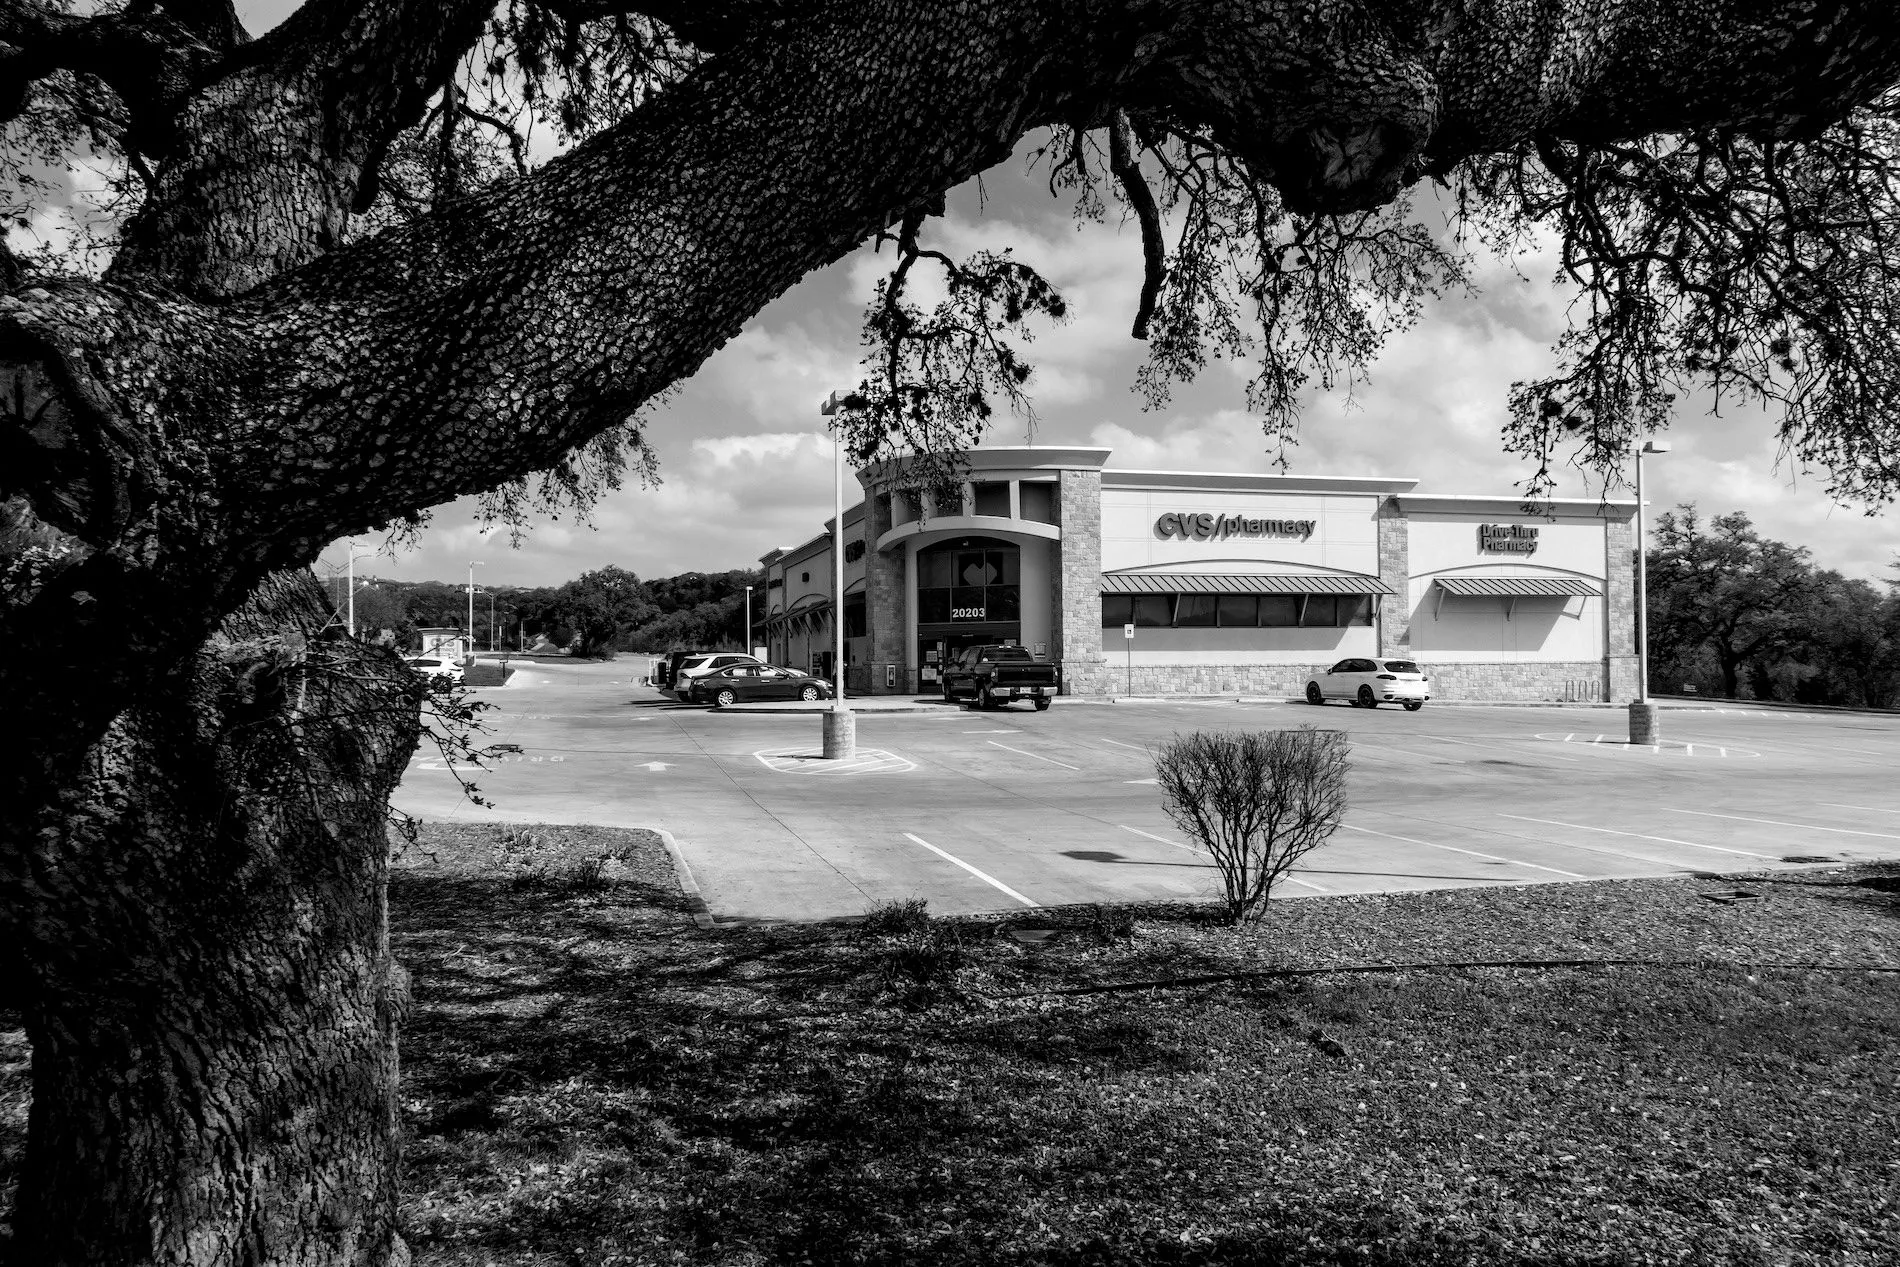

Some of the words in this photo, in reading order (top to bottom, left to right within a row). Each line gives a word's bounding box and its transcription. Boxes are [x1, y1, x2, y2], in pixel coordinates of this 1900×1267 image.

[1155, 512, 1316, 541] CVS/pharmacy
[1480, 537, 1539, 556] Pharmacy
[952, 607, 985, 618] 20203
